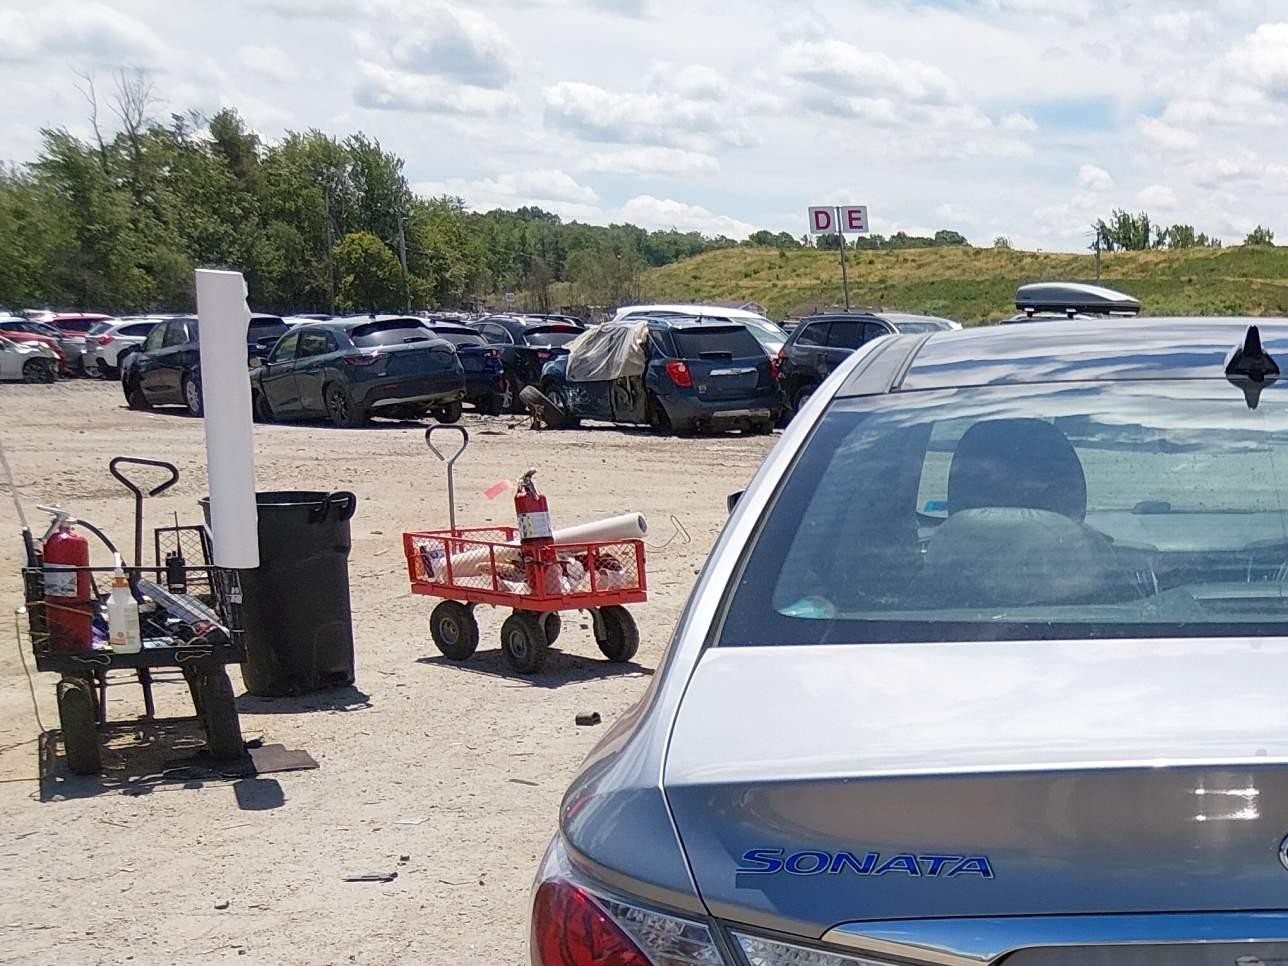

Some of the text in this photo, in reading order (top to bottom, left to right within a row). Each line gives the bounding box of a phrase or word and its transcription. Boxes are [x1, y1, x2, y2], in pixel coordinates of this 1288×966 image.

[814, 210, 831, 230] D
[848, 210, 863, 229] E
[736, 848, 995, 879] SONATA
